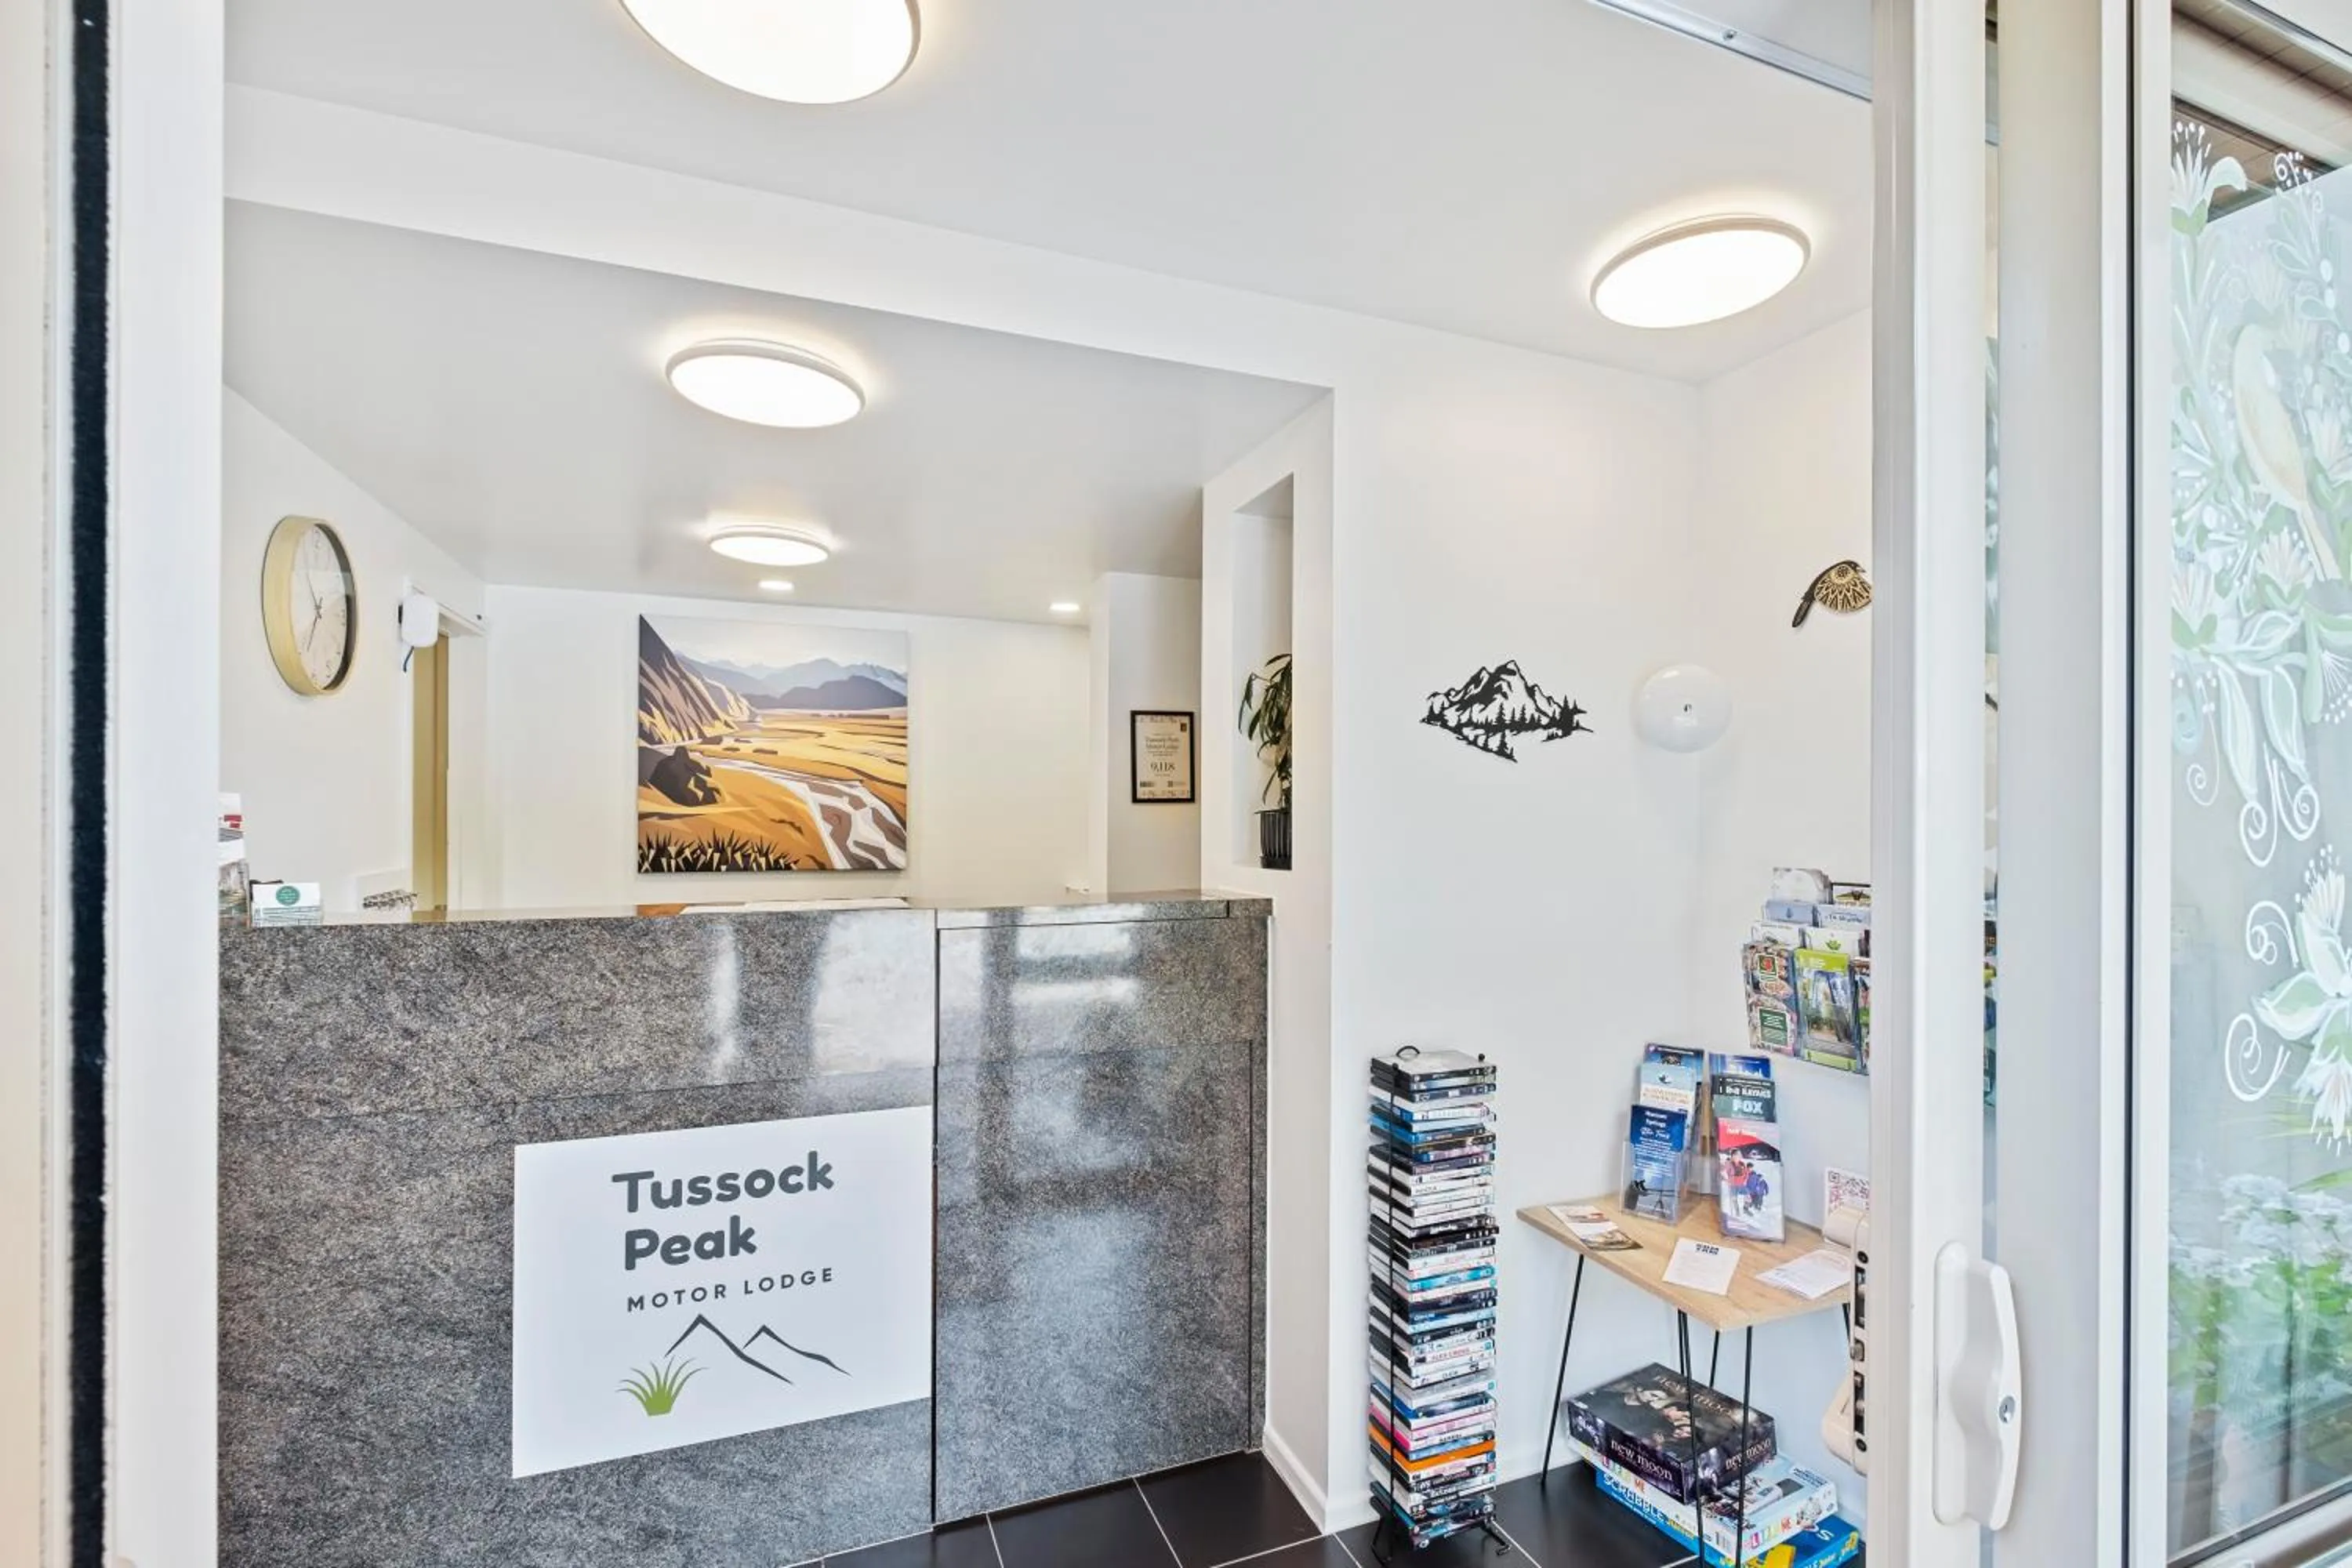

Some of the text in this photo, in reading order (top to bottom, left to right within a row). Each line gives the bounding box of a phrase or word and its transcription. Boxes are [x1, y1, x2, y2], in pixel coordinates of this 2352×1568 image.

[612, 1150, 835, 1213] Tussock
[625, 1214, 757, 1271] Peak
[627, 1268, 833, 1312] MOTOR LODGE
[1611, 1439, 1673, 1482] new moon
